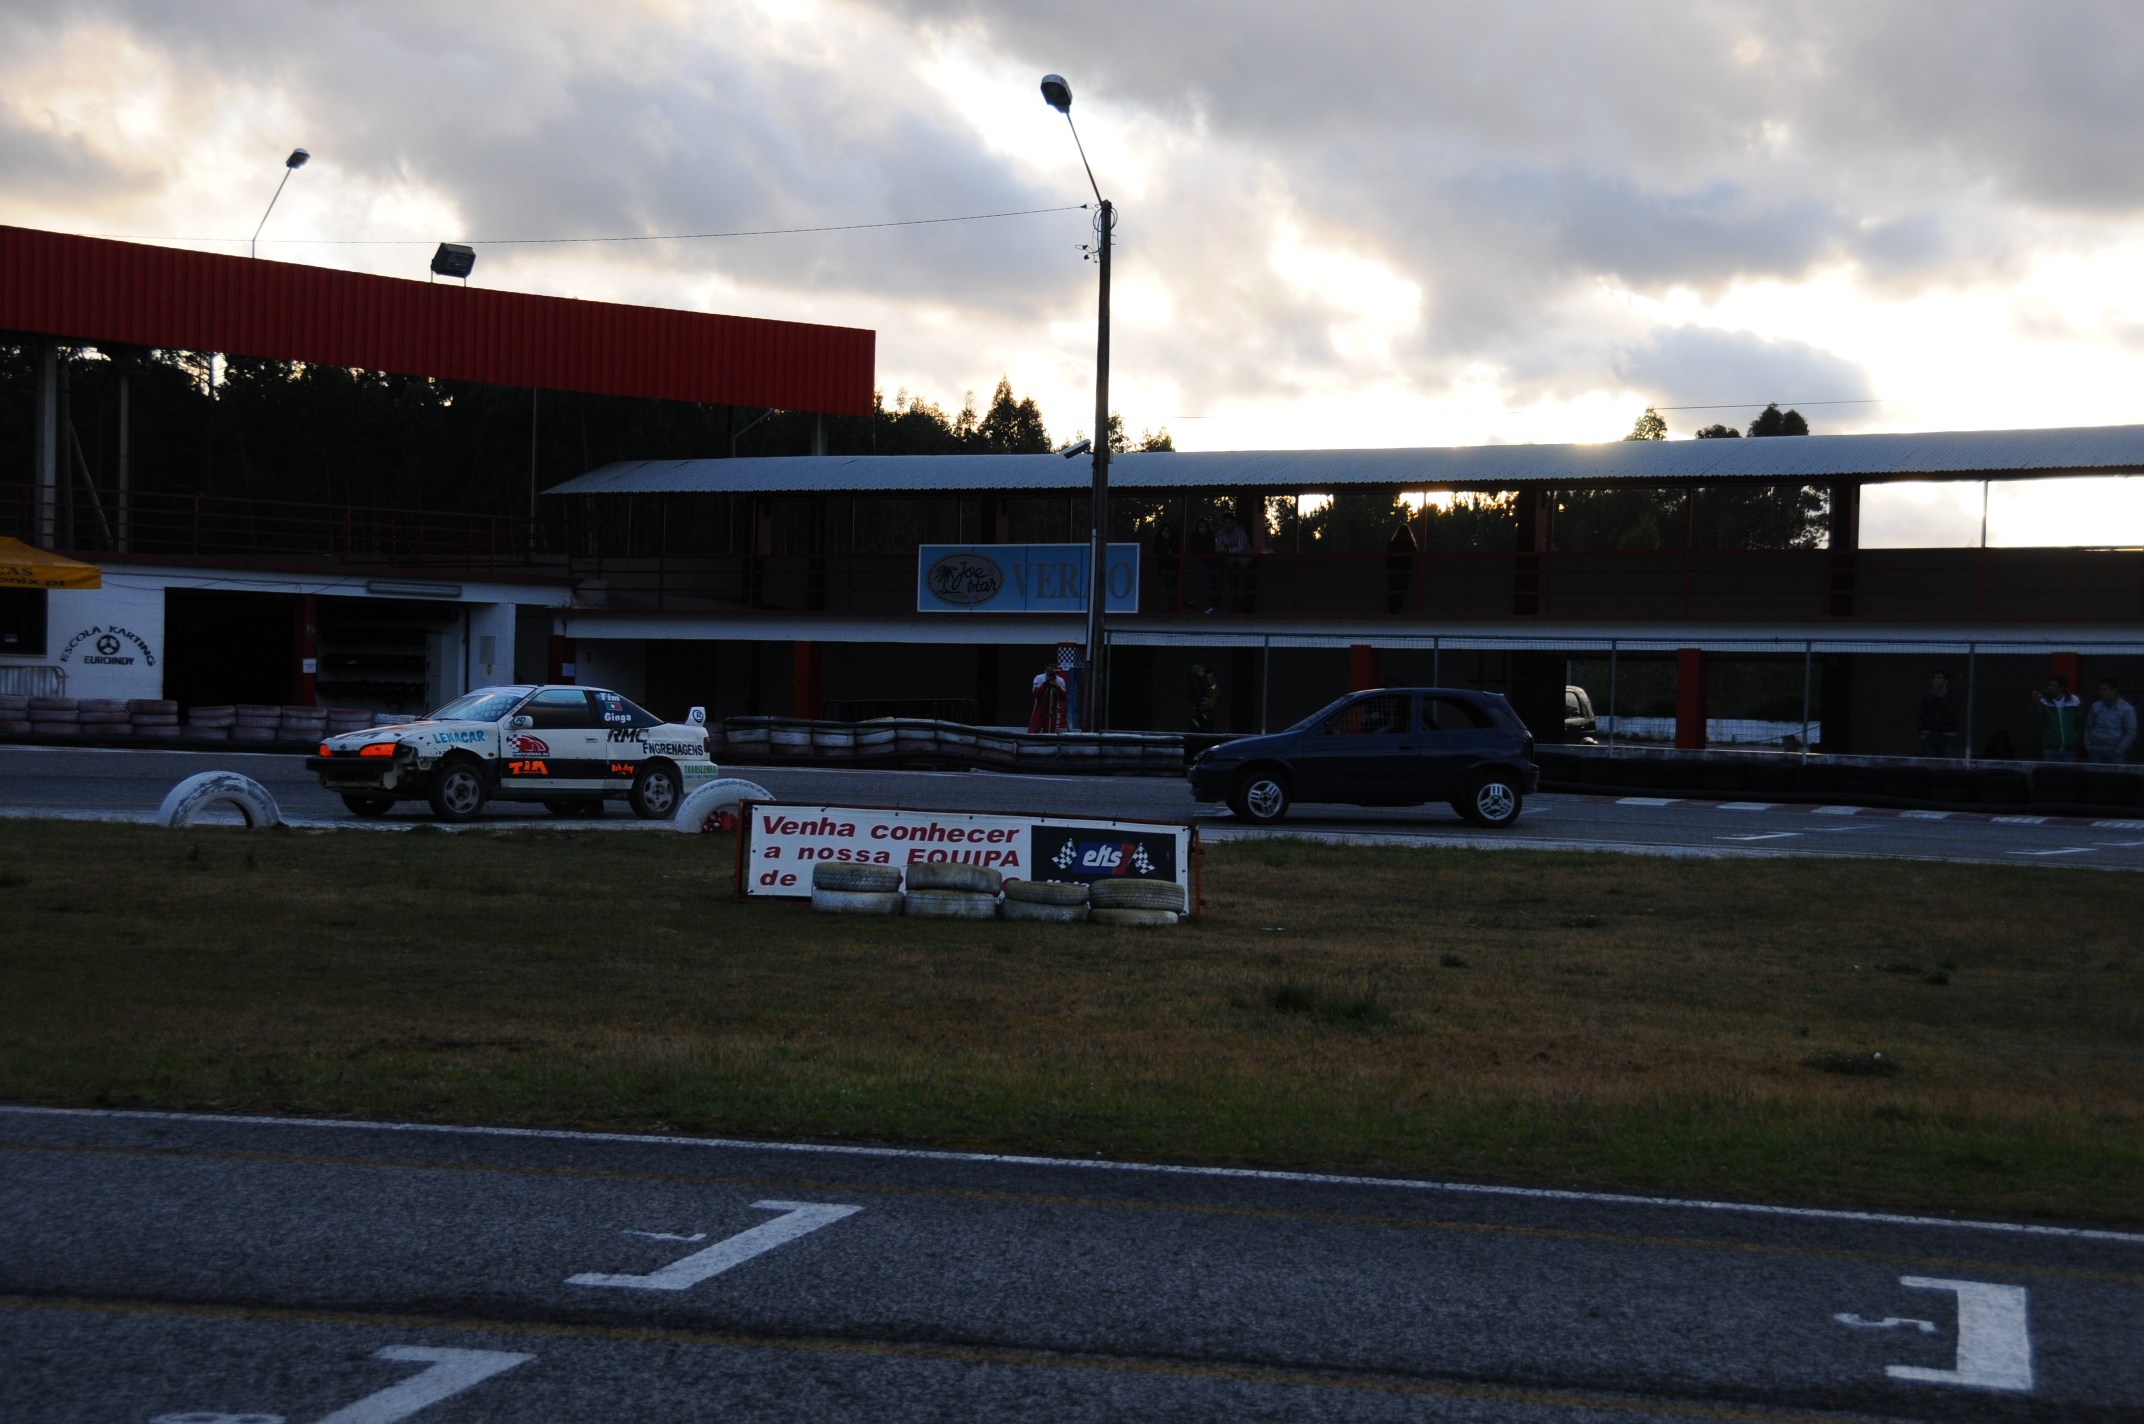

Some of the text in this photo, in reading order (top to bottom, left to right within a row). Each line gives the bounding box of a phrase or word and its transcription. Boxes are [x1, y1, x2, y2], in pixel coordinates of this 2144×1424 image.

[951, 561, 987, 590] Joe
[1011, 561, 1133, 599] VERO
[61, 626, 156, 667] ESCOLA KARTING
[84, 656, 135, 665] EUROINDY
[600, 693, 620, 702] Tim
[604, 712, 632, 724] Ginga
[433, 730, 486, 744] LENACAR
[607, 728, 650, 743] RMC
[643, 742, 704, 756] ENGRENAGENS
[763, 816, 1020, 843] Venha conhecer
[764, 846, 1020, 866] a nossa EQUIPA
[760, 870, 797, 887] de
